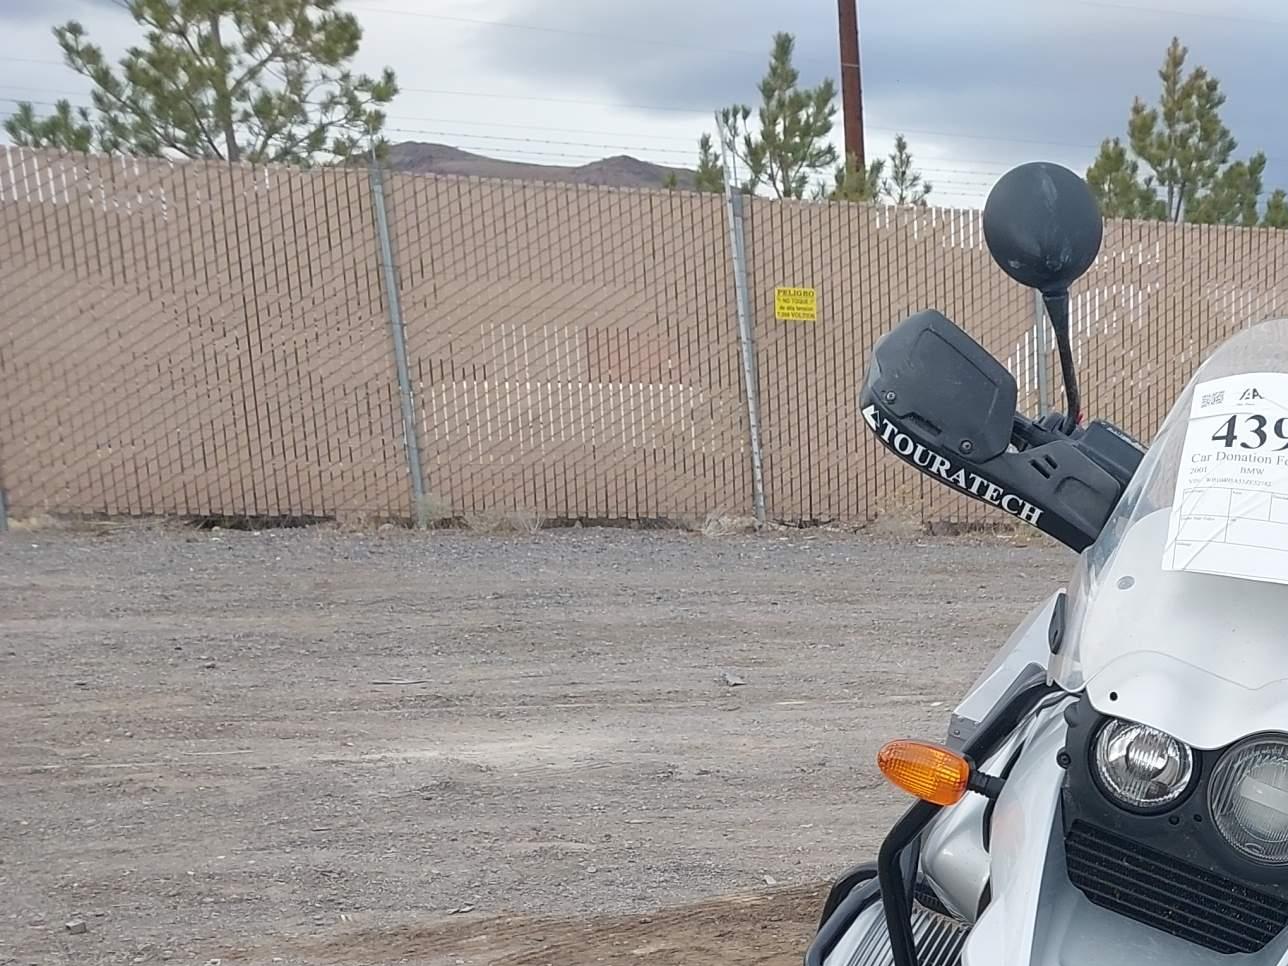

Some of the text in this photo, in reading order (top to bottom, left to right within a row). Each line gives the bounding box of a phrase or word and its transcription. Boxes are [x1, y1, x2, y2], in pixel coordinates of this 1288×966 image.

[879, 418, 1044, 527] TOURATECH
[1191, 453, 1212, 464] Car
[1216, 451, 1272, 465] Donation
